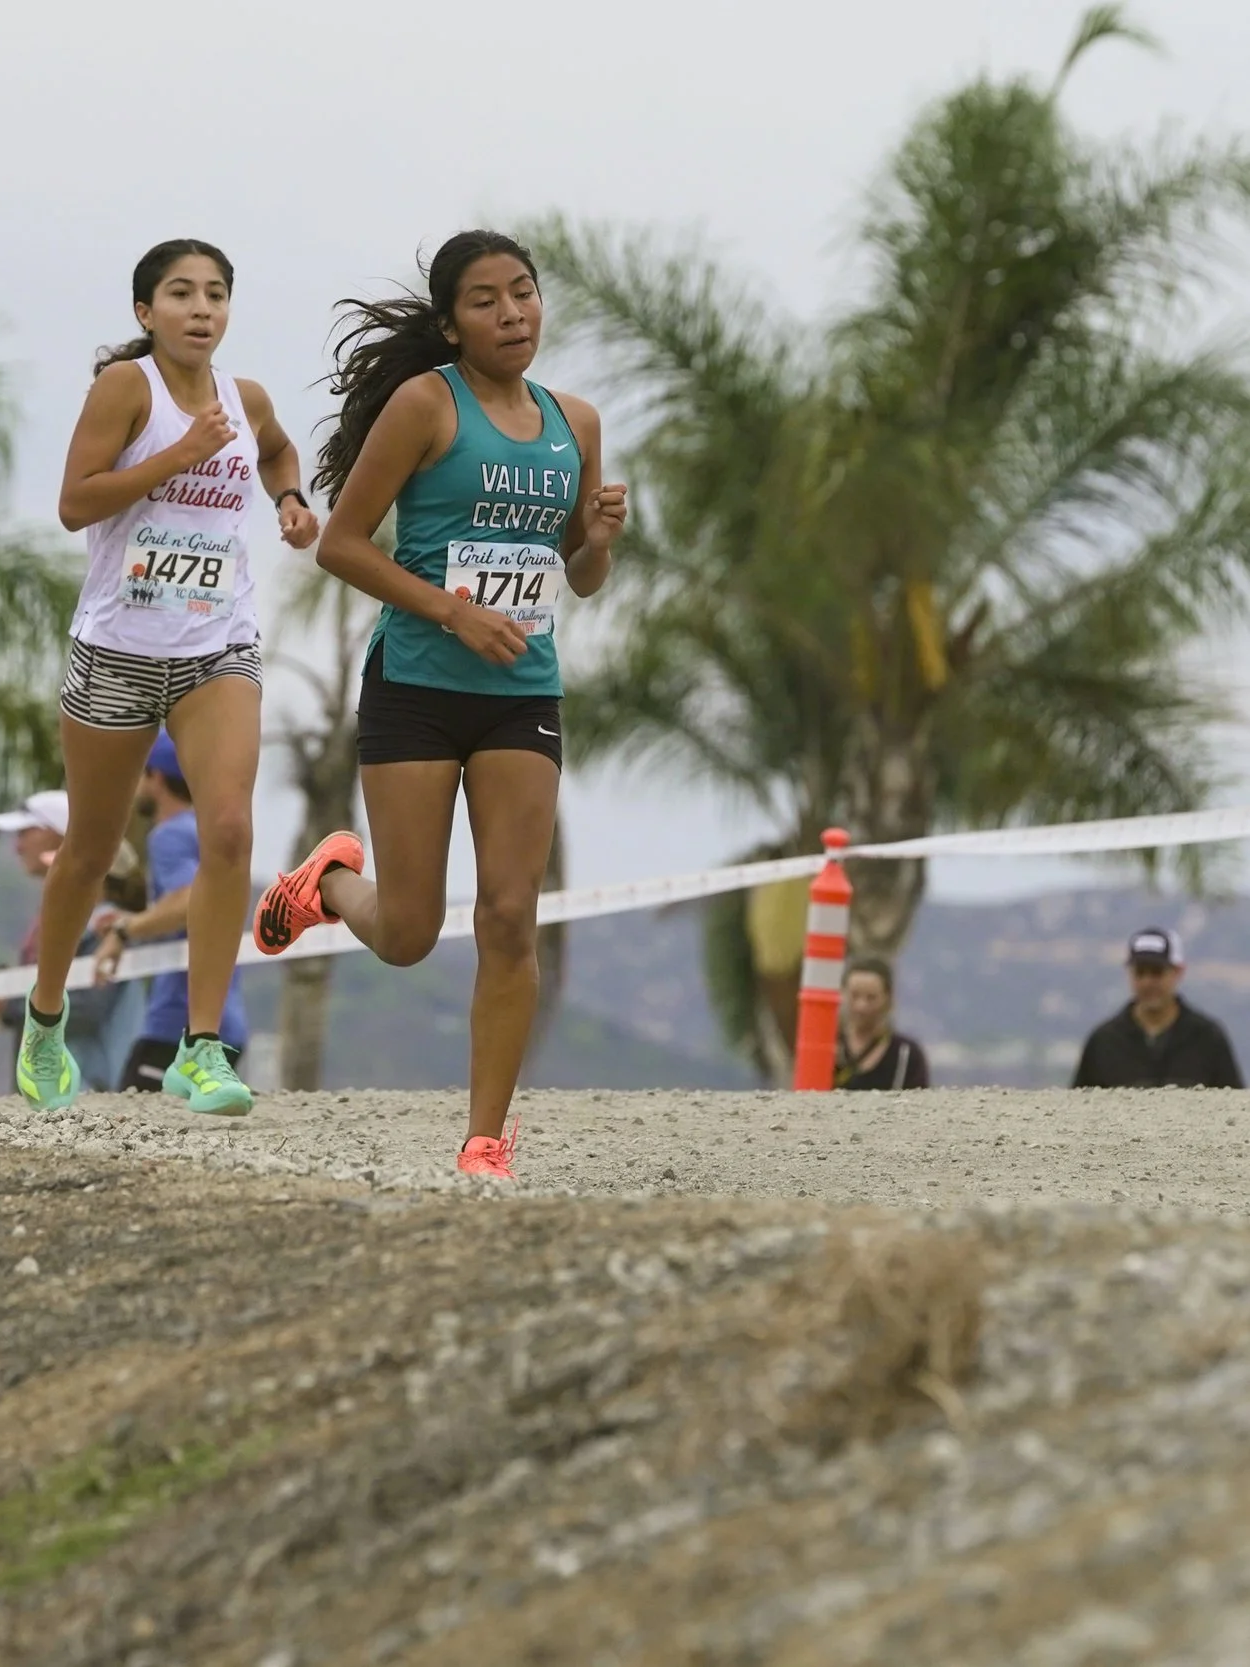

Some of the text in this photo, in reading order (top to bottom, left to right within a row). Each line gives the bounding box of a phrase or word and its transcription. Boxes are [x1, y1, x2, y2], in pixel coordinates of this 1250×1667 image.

[227, 456, 251, 481] Fe
[481, 462, 572, 500] VALLEY
[147, 479, 244, 512] Christian
[471, 501, 567, 534] CENTER
[137, 527, 168, 547] Grit
[188, 533, 232, 553] Grind
[143, 550, 223, 588] 1478
[458, 544, 494, 567] Grit
[517, 547, 558, 570] Grind
[475, 571, 545, 606] 1714
[517, 609, 546, 623] Challenge
